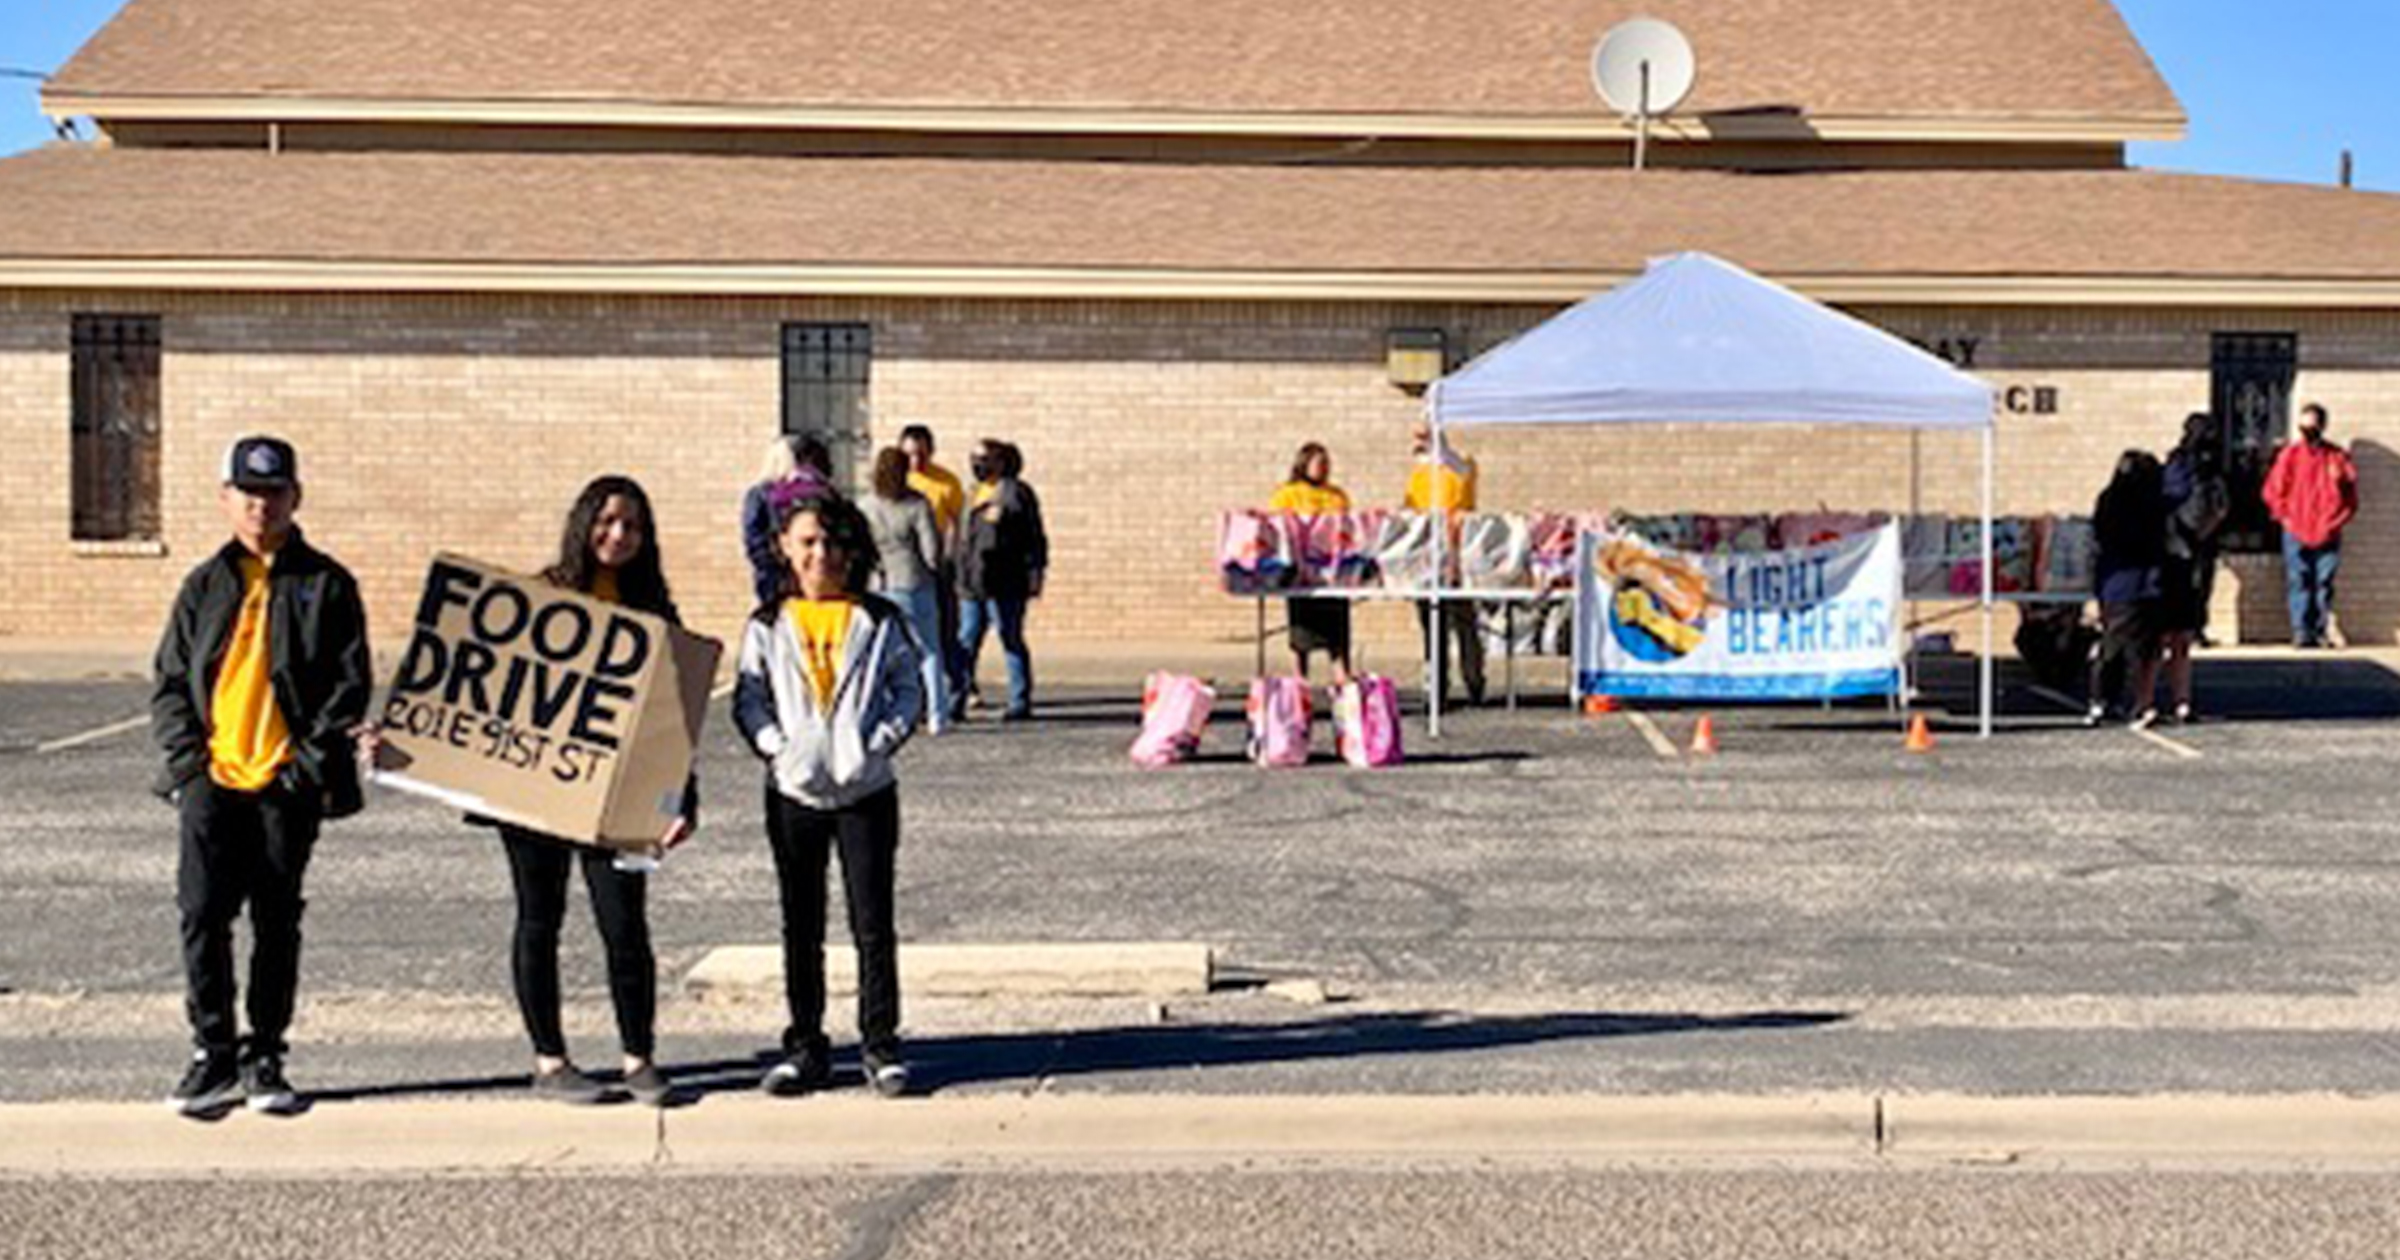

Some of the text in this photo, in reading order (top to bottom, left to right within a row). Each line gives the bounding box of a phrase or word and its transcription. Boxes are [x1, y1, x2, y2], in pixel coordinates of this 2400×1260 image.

[1992, 385, 2058, 414] CH
[1727, 556, 1828, 606] LIGHT
[416, 560, 648, 678] FOOD
[394, 627, 636, 751] DRIVE
[551, 741, 610, 783] ST
